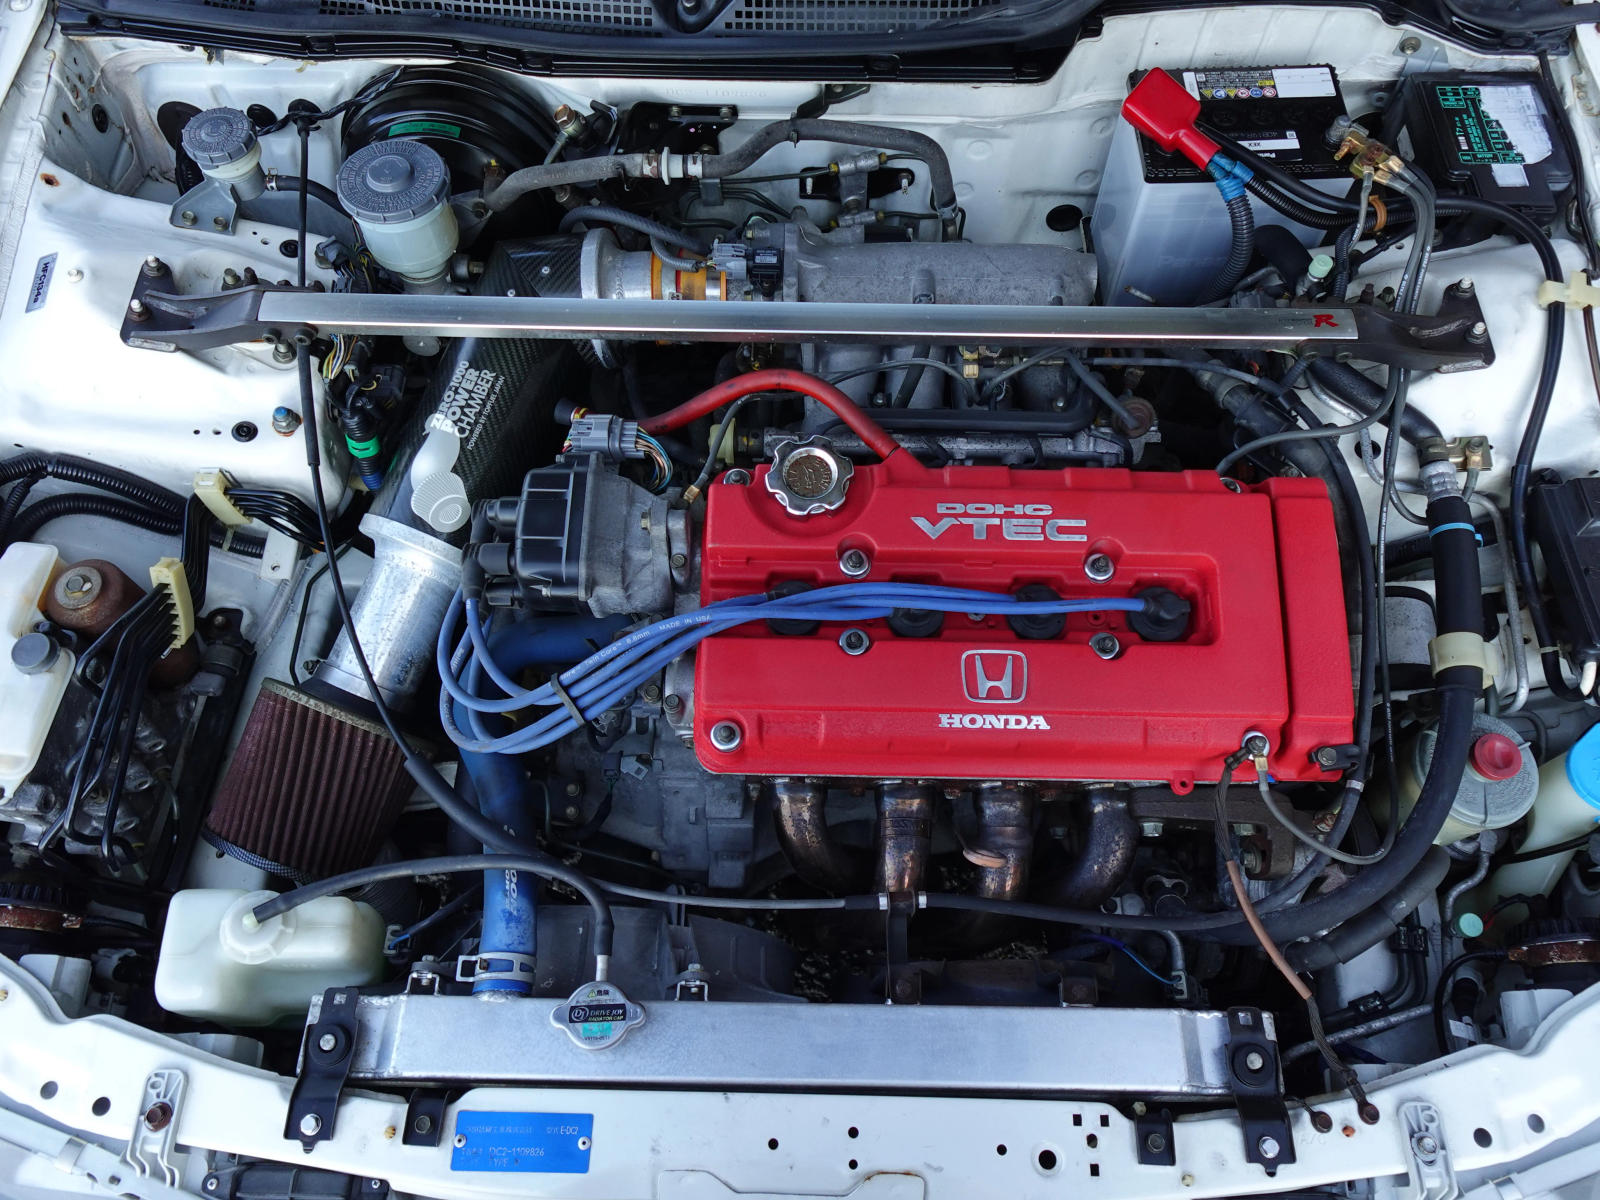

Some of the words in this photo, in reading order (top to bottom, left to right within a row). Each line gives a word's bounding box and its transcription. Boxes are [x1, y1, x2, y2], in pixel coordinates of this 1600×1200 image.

[1312, 313, 1340, 328] R
[495, 375, 506, 394] JAPAN
[430, 360, 469, 430] ZERO-1000
[440, 368, 480, 433] POWER
[454, 369, 496, 438] CHAMBER
[483, 392, 499, 416] TOPFUEL
[481, 416, 489, 424] BY
[467, 423, 483, 450] POWERED
[937, 503, 1053, 515] DOHC
[910, 517, 1087, 541] VTEC
[658, 620, 680, 631] MADE
[684, 617, 692, 625] IN
[695, 614, 712, 623] USA
[938, 713, 1051, 730] HONDA
[590, 1009, 611, 1017] DRIVE
[611, 1008, 624, 1016] JOY
[560, 1126, 579, 1135] E-DC2
[489, 1147, 545, 1157] DC2-1109826
